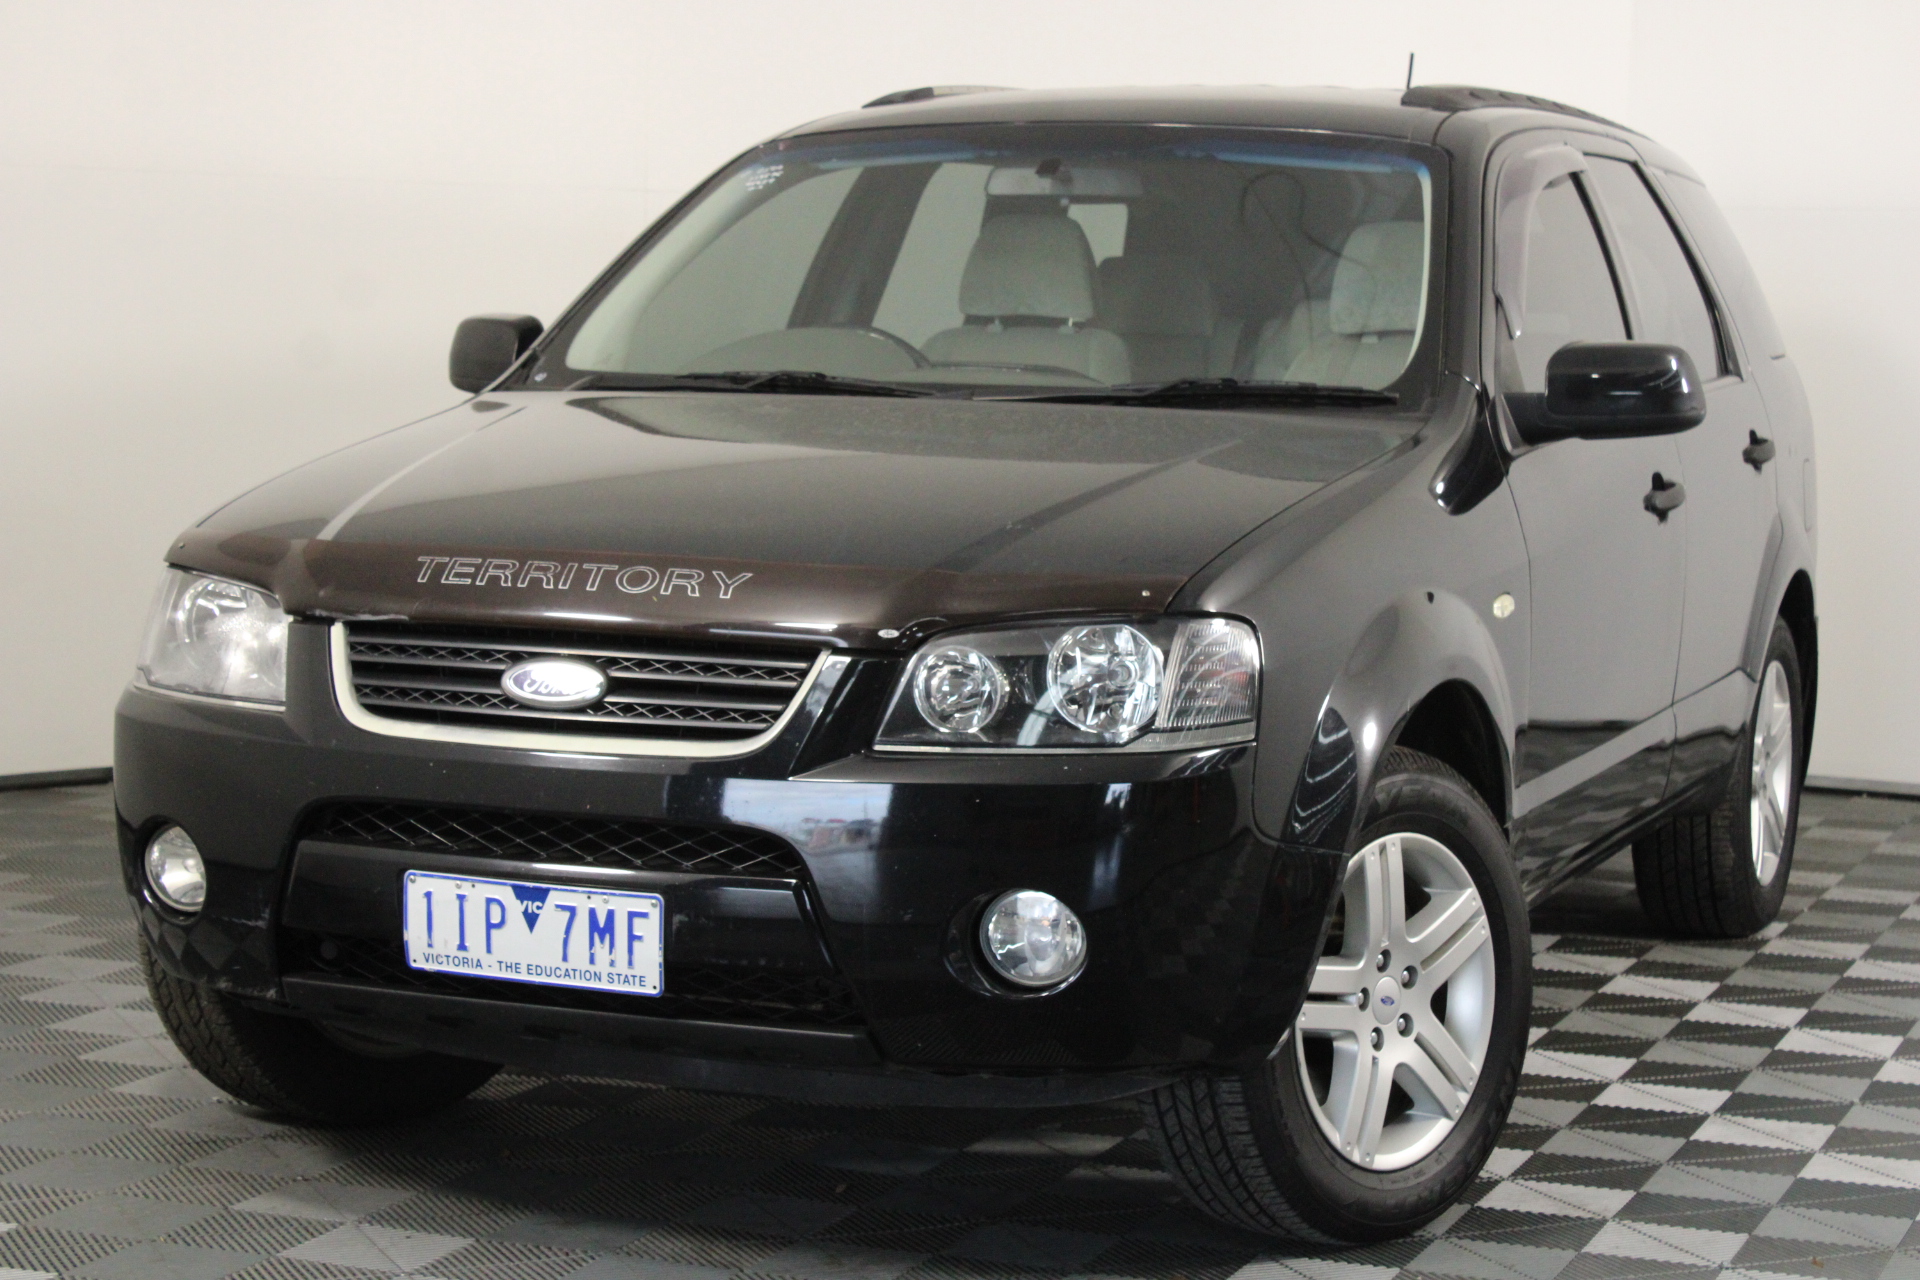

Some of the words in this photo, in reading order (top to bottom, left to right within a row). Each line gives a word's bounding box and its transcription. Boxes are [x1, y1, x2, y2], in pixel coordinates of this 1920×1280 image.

[416, 556, 753, 599] TERRITORY
[517, 900, 544, 915] VIC
[422, 890, 507, 954] 1IP
[553, 903, 650, 970] 7MF
[422, 952, 483, 970] VICTORIA
[496, 960, 522, 974] THE
[526, 964, 602, 983] EDUCATION
[607, 972, 647, 987] STATE
